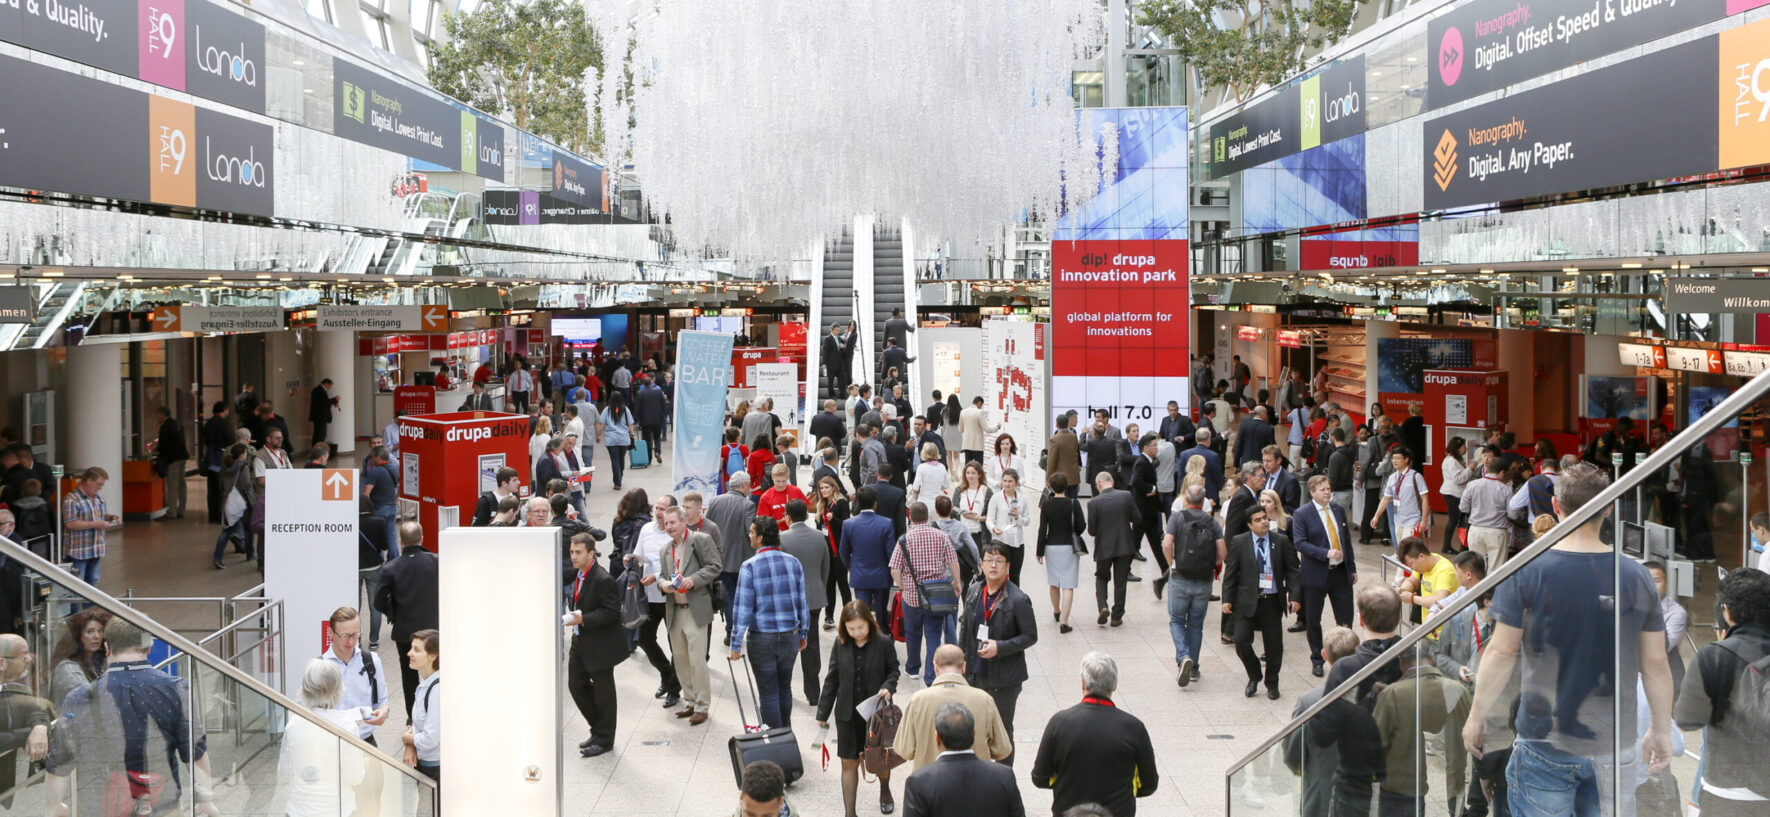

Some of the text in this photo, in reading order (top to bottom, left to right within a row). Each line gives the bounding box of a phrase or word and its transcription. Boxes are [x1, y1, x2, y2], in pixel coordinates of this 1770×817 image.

[45, 0, 108, 42] Quality.
[149, 6, 160, 54] HALL
[159, 13, 176, 59] 9
[1474, 39, 1513, 70] Digital.
[1516, 23, 1553, 54] Offset
[1556, 0, 1600, 43] Speed
[1604, 0, 1616, 23] &
[1475, 3, 1531, 39] Nanography.
[196, 24, 256, 87] Landa
[1324, 81, 1360, 123] Landa
[1735, 62, 1751, 127] HALL
[371, 110, 444, 149] Digital. Lowest Print Cost.
[1309, 98, 1317, 129] 9
[1469, 115, 1528, 147] Nanography.
[160, 125, 171, 173] HALL
[170, 129, 186, 175] 9
[206, 135, 265, 189] Landa
[1469, 142, 1574, 181] Digital. Any Paper.
[1060, 269, 1177, 284] innovation park
[1081, 253, 1156, 268] dip! drupa
[1674, 283, 1716, 294] Welcome
[323, 308, 393, 317] Exhibitors entrance
[323, 318, 401, 328] Aussteller-Eingang
[1067, 312, 1172, 323] global platform for
[684, 338, 729, 352] COFFEE
[1087, 326, 1152, 336] innovations
[681, 364, 726, 387] BAR
[1088, 405, 1152, 420] hll 7.0
[271, 523, 353, 533] RECEPTION ROOM
